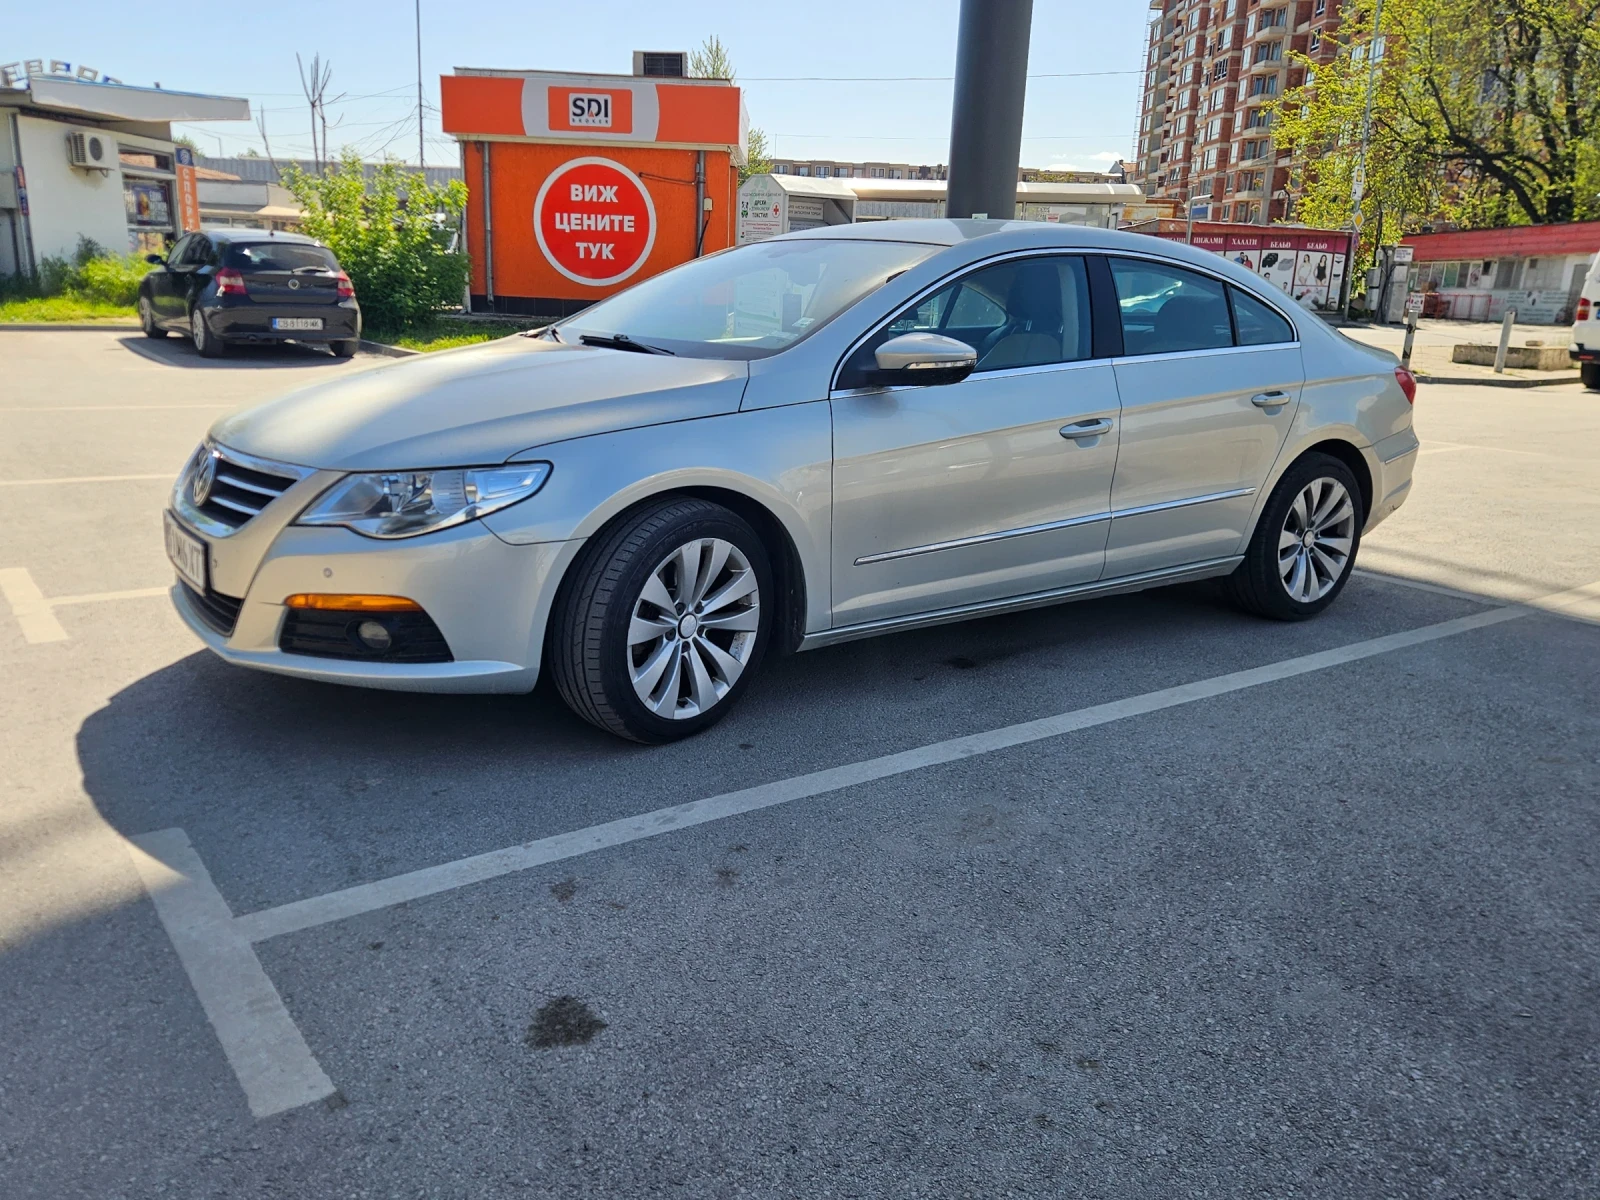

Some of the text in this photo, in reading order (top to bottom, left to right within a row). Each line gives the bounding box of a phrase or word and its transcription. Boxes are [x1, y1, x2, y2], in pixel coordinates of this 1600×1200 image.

[572, 97, 609, 118] SDI
[182, 167, 194, 229] СПОРТ
[570, 184, 619, 203] ВИЖ
[555, 212, 635, 233] ЦЕНИТЕ
[1231, 237, 1258, 246] ХАЛАТИ
[1270, 241, 1292, 249] БЕЛЬО
[1307, 242, 1328, 250] БЕЛЬО
[575, 242, 615, 260] ТУК
